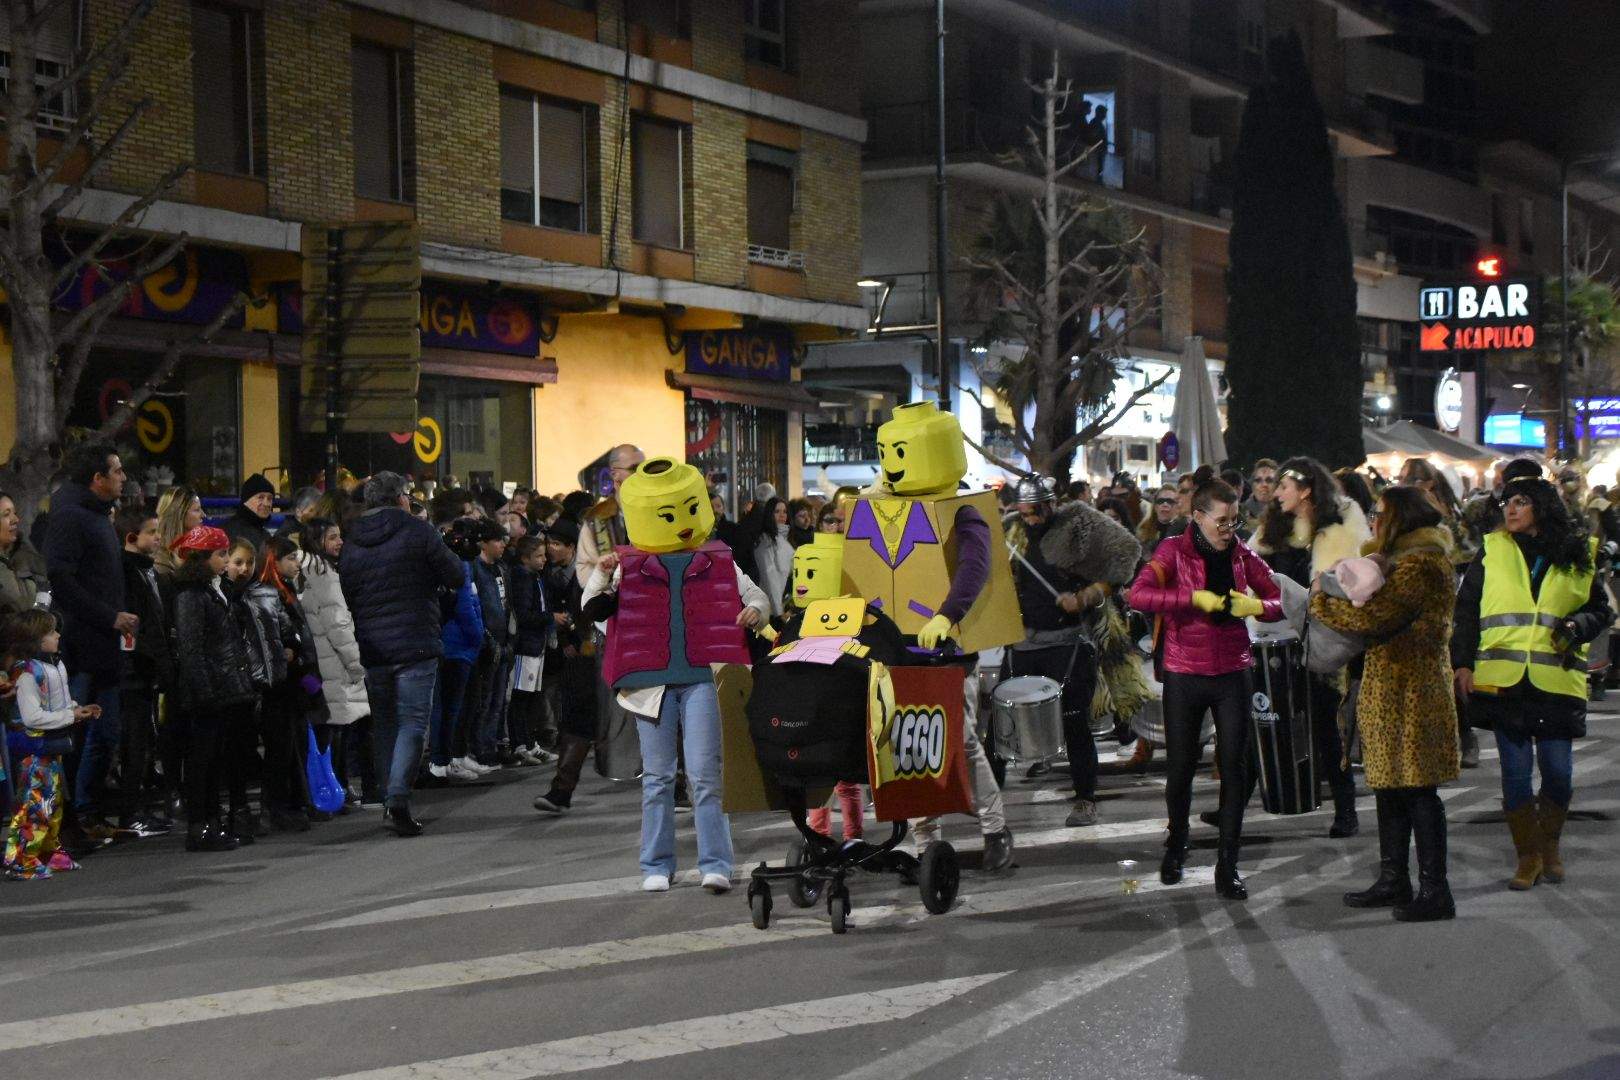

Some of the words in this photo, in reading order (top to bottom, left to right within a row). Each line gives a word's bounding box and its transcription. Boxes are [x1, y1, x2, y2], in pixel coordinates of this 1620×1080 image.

[1457, 283, 1529, 318] BAR
[701, 334, 778, 369] GANGA
[1454, 325, 1535, 349] ACAPULCO
[890, 713, 944, 772] LEGO
